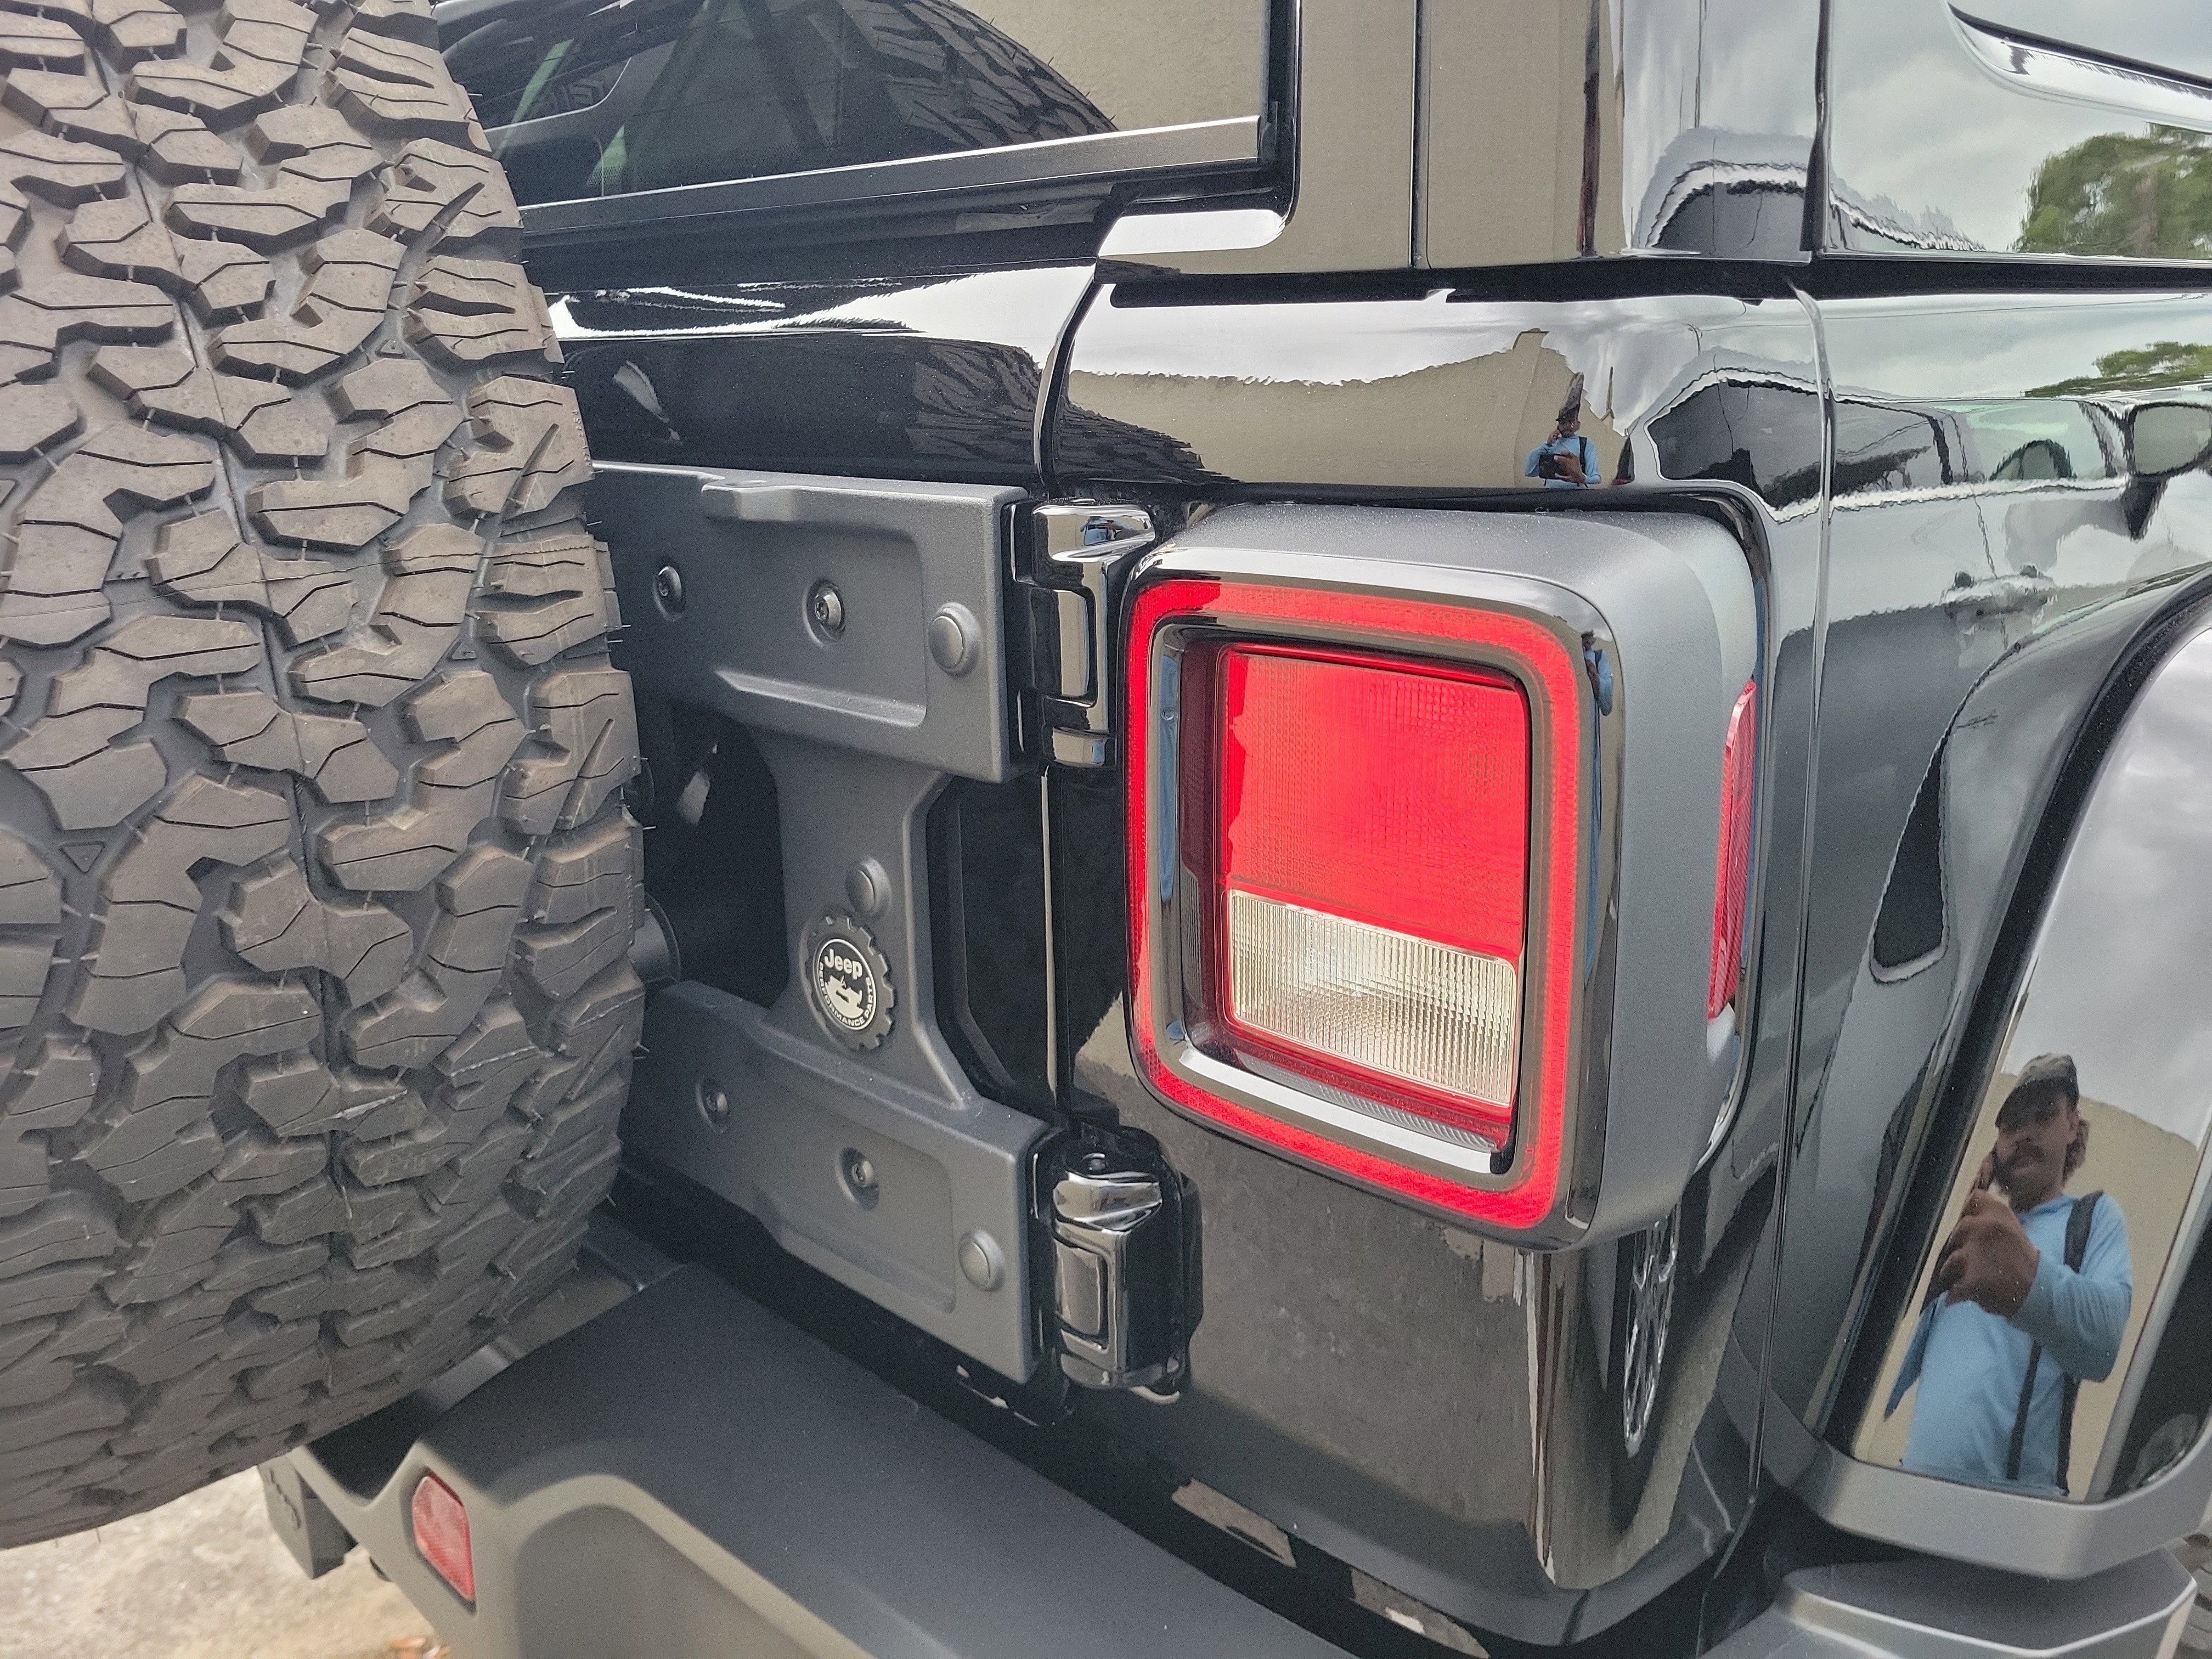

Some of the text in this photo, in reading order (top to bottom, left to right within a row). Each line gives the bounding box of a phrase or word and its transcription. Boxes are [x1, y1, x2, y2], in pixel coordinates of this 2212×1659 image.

[824, 948, 863, 980] Jeep
[819, 962, 873, 1026] PERFORMANCE PARTS
